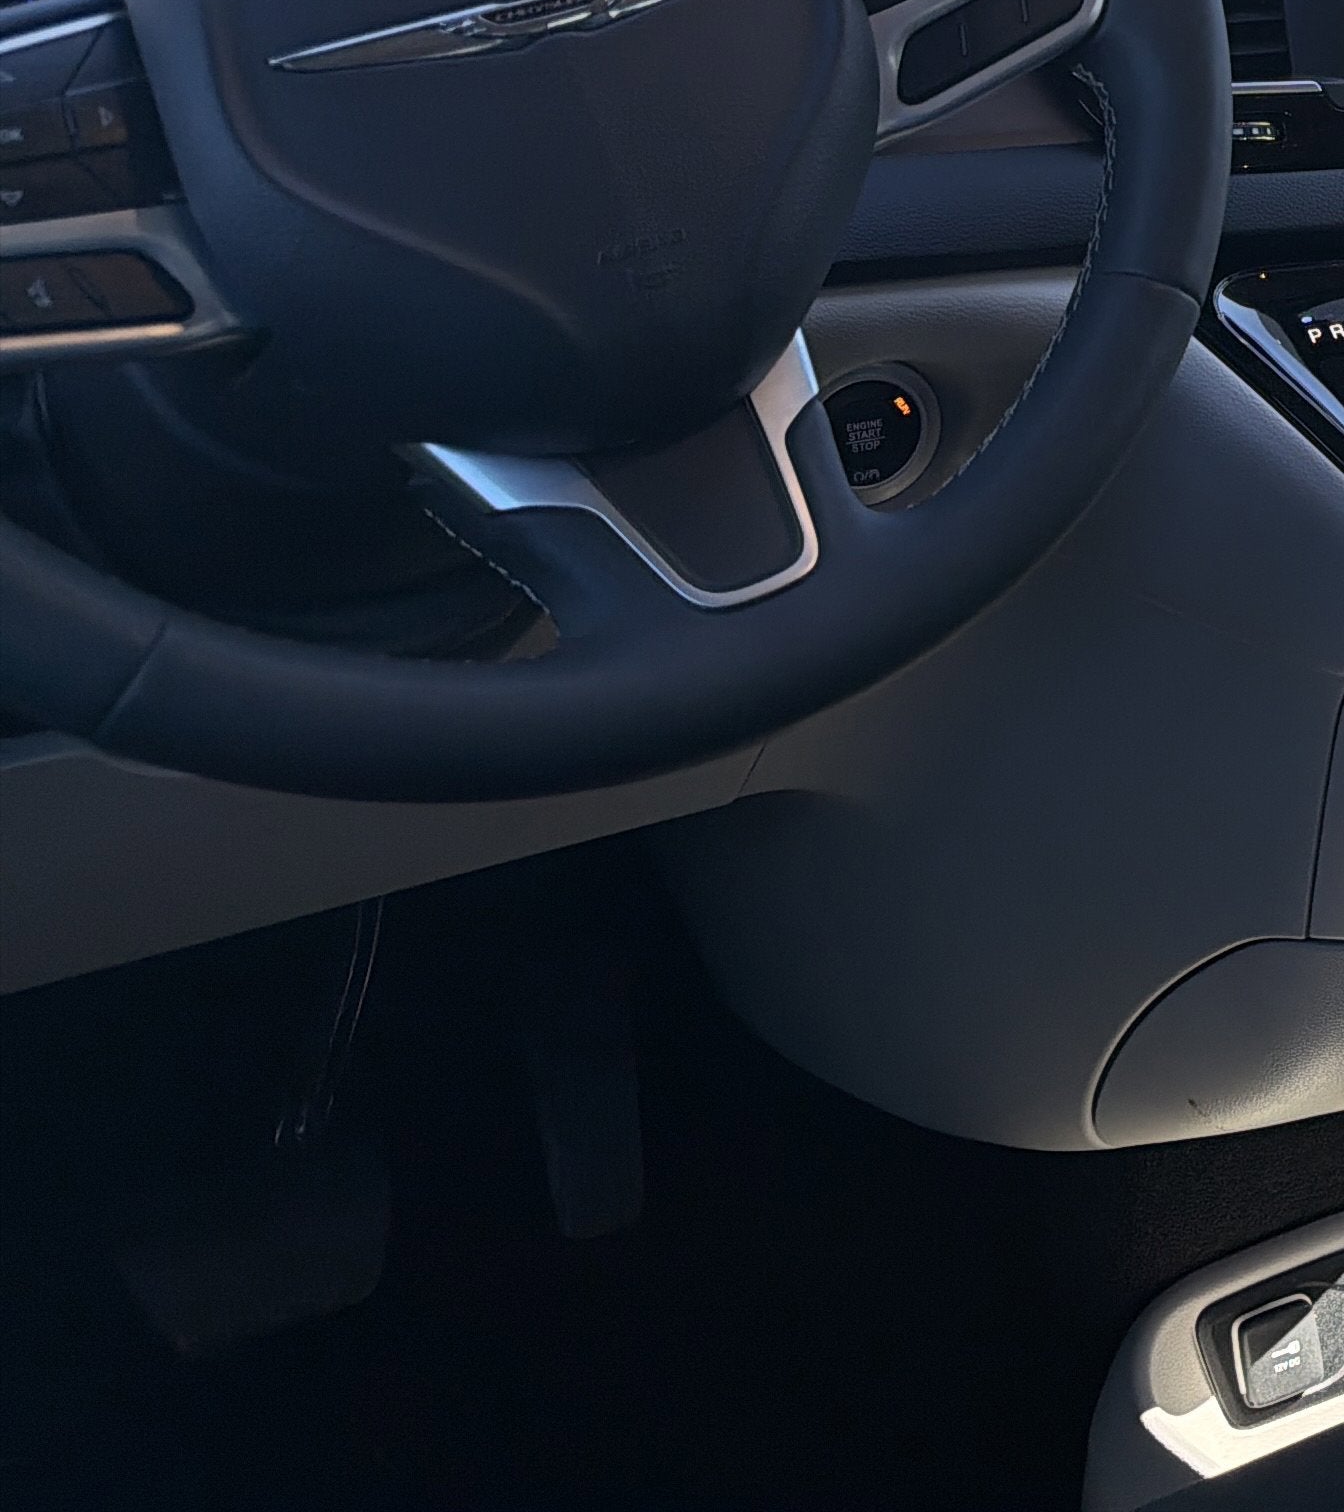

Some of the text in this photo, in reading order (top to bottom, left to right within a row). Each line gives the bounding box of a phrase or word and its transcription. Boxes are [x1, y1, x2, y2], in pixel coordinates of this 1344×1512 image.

[893, 396, 911, 416] RUN
[846, 418, 883, 433] ENGINE
[848, 428, 882, 441] START
[851, 440, 880, 454] STOP
